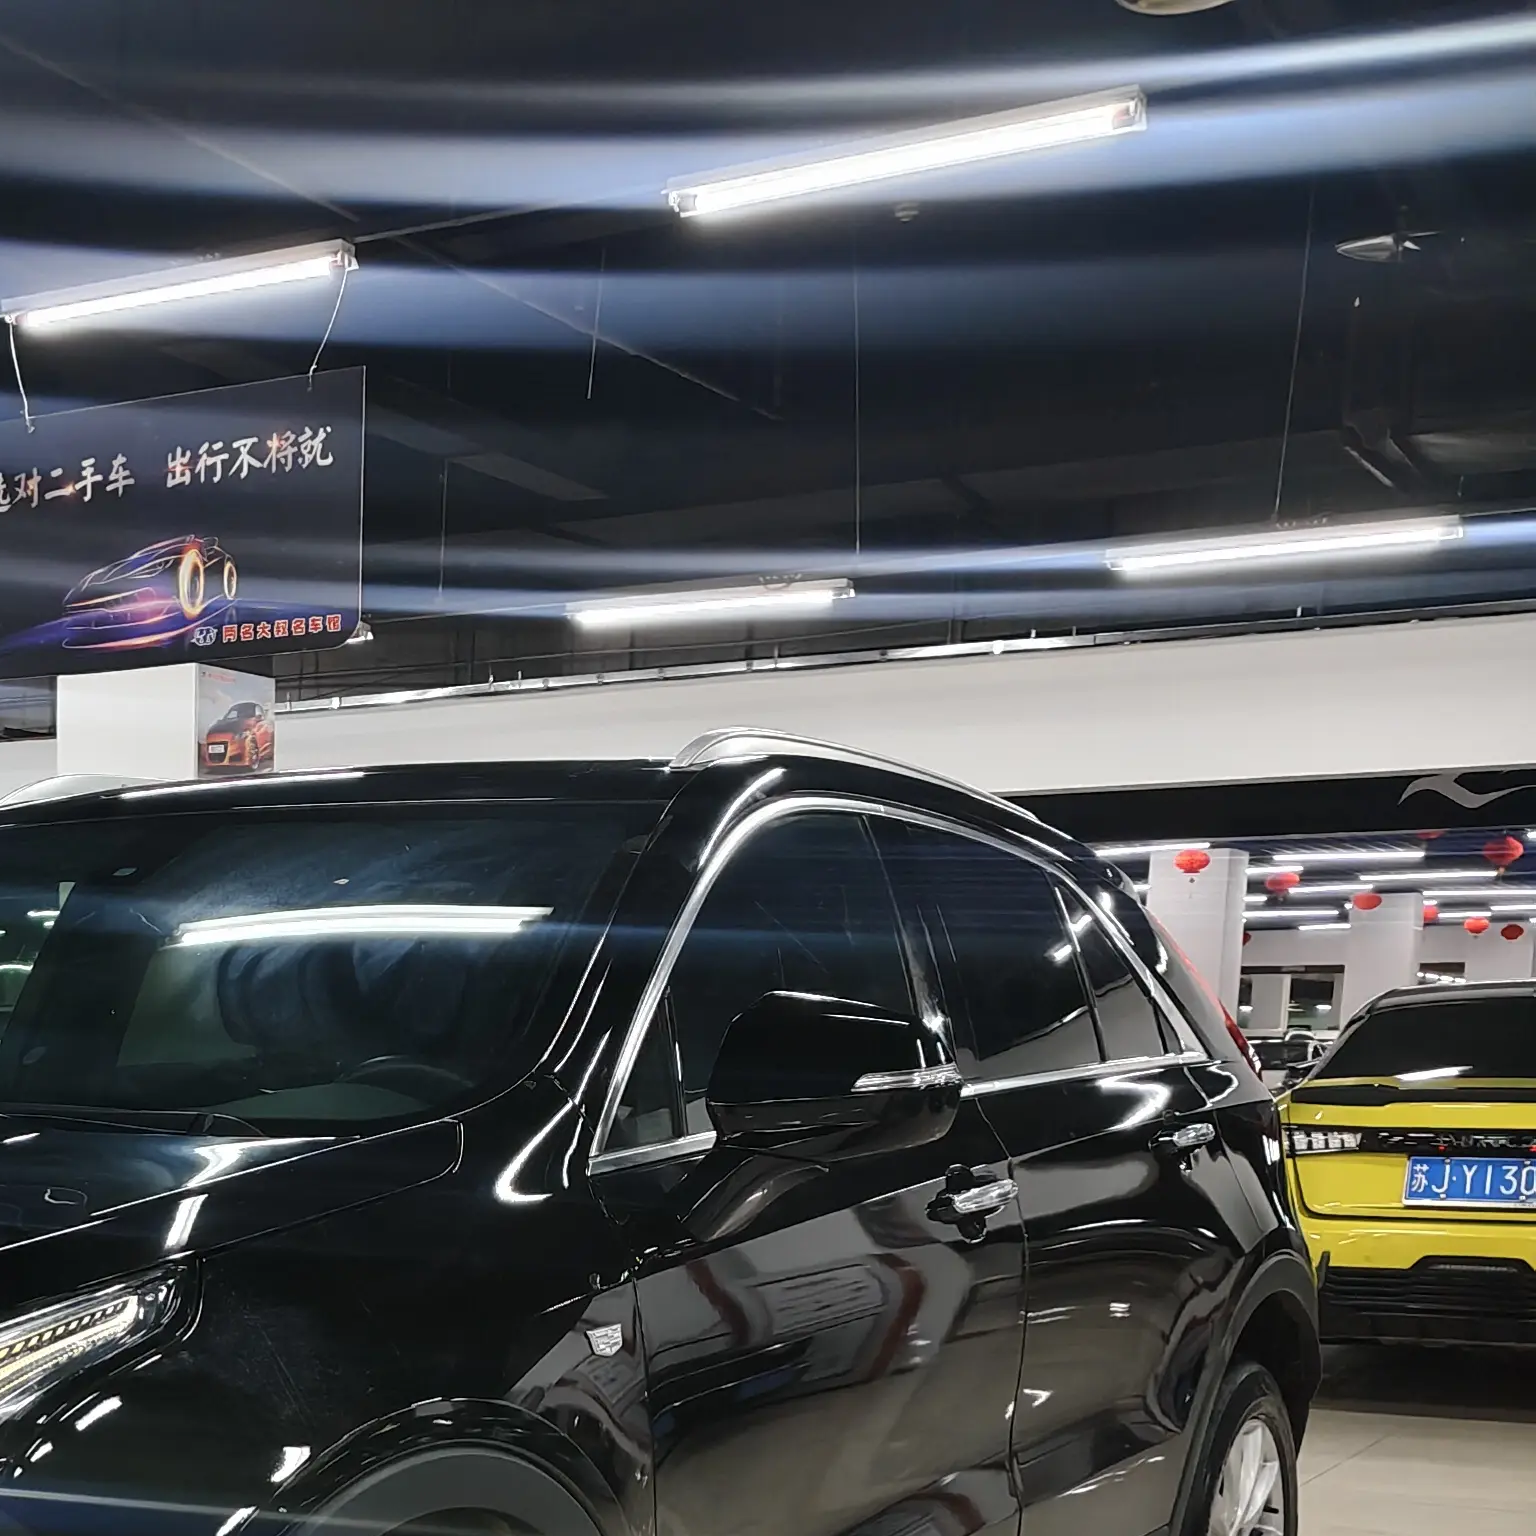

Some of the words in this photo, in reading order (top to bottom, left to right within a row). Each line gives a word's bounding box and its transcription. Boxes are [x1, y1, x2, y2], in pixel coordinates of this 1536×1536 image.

[166, 426, 335, 488] 出行不将就
